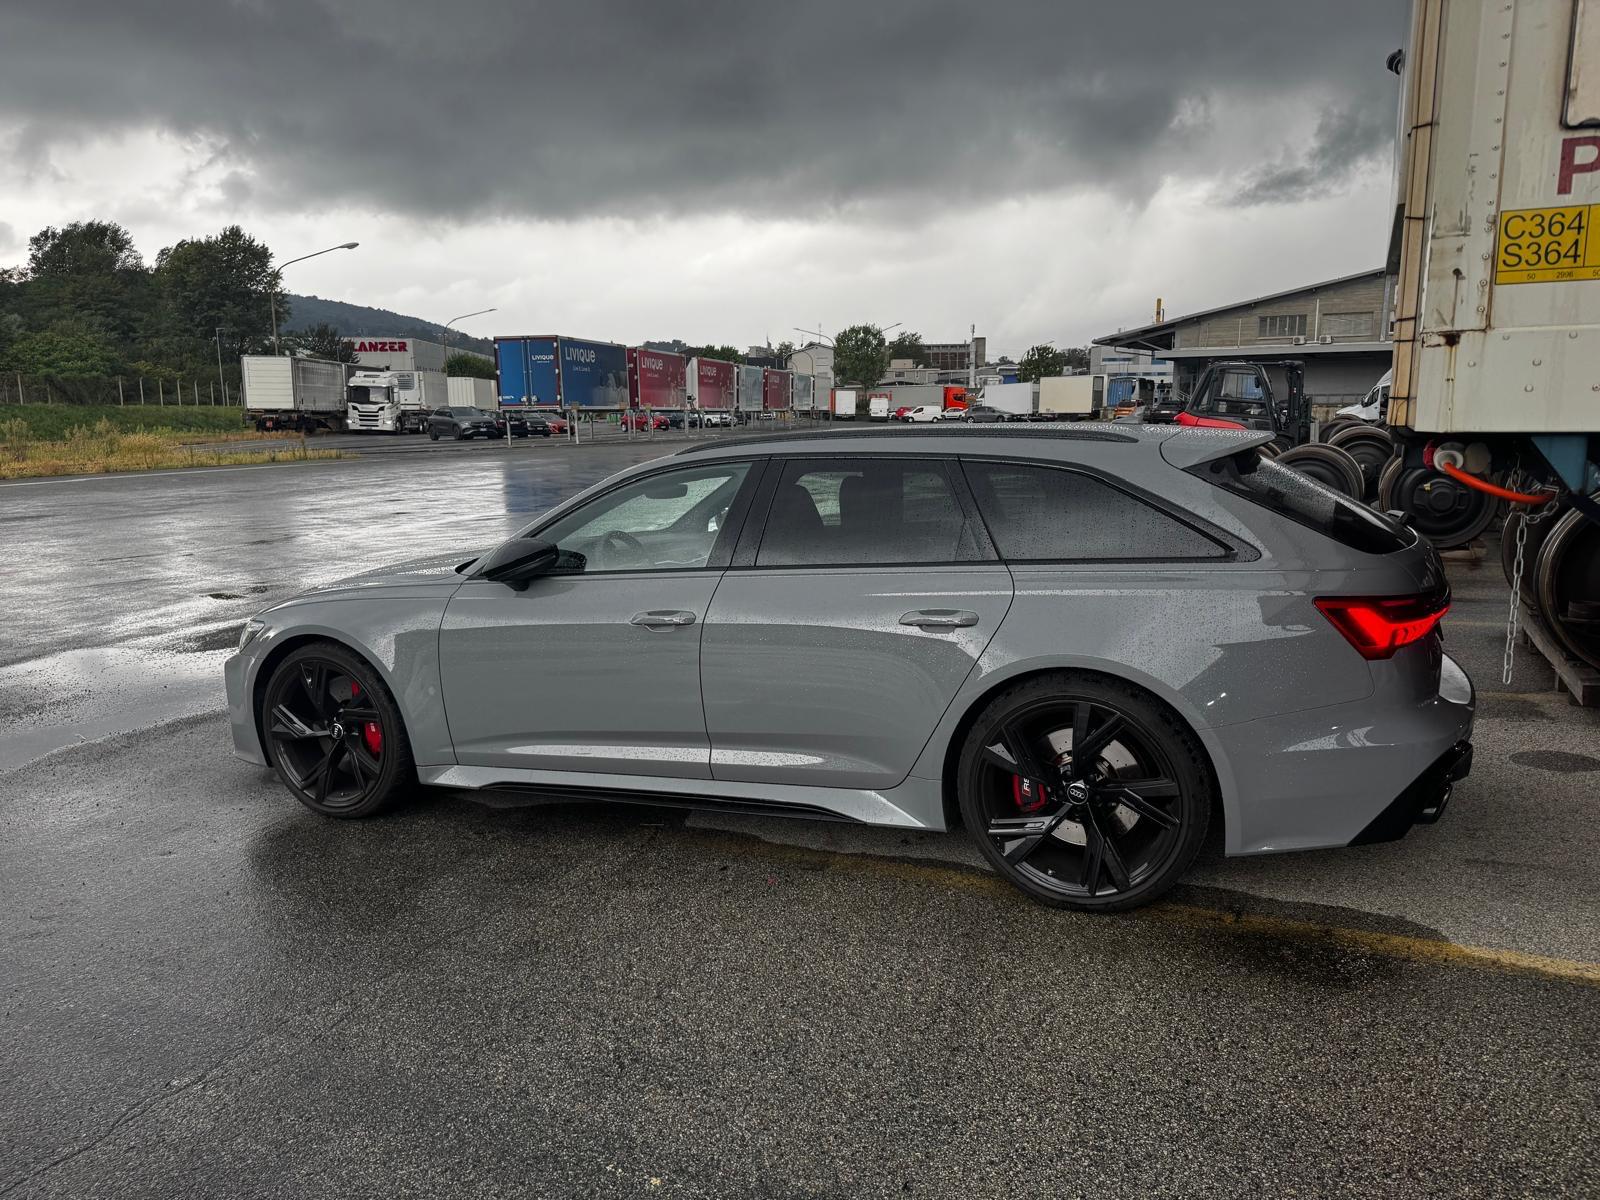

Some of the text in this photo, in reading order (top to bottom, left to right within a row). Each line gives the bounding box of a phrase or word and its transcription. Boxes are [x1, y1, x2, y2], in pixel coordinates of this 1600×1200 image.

[1504, 211, 1584, 240] C364
[1502, 239, 1580, 267] S364
[343, 341, 408, 353] LANZER
